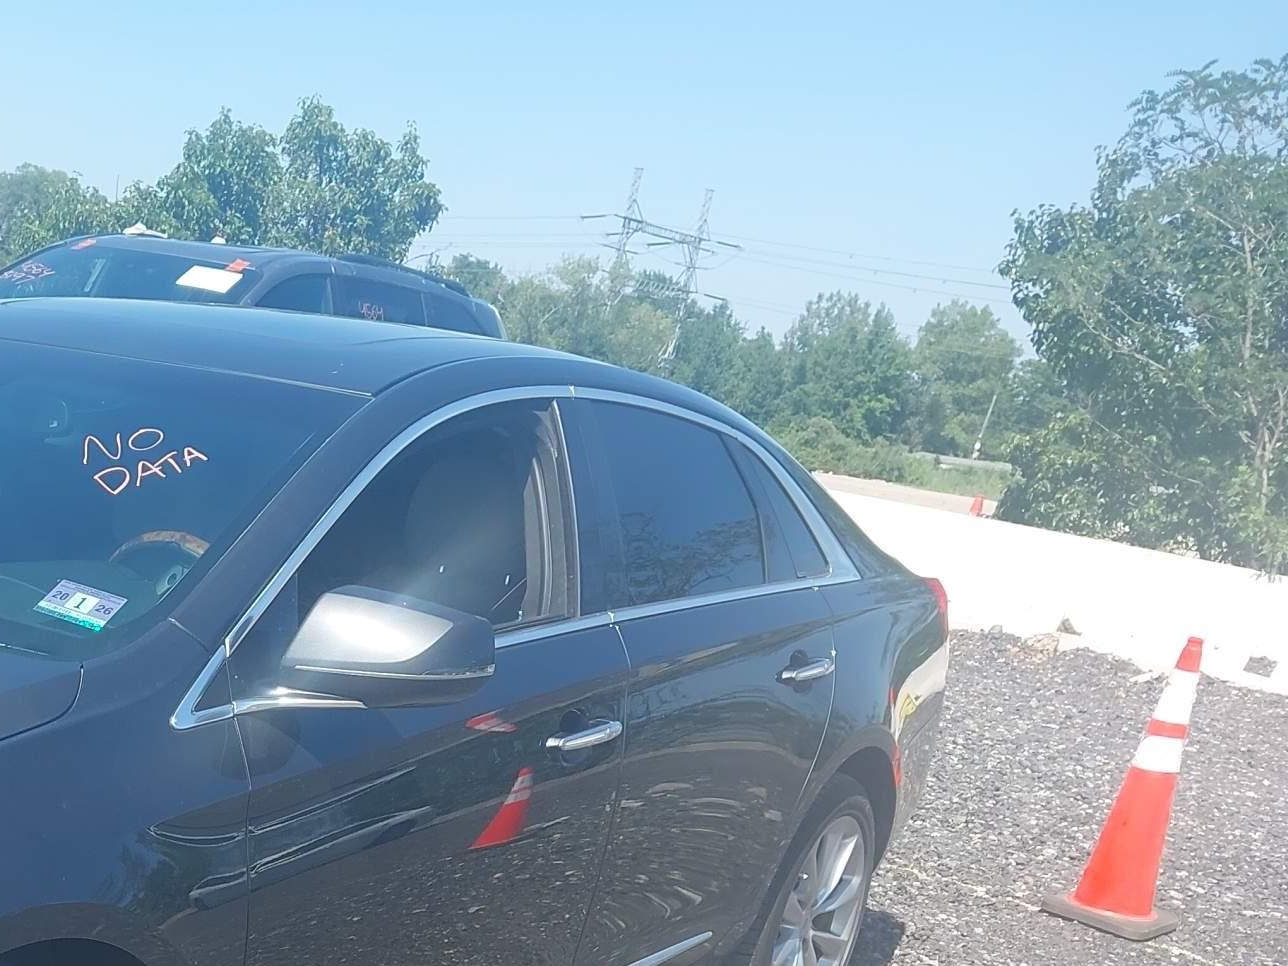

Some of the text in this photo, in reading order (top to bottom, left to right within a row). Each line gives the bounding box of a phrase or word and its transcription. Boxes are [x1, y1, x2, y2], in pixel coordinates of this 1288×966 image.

[82, 428, 164, 465] NO
[93, 446, 209, 495] DATA
[51, 590, 71, 601] 20
[73, 597, 88, 610] 1
[94, 604, 114, 616] 26
